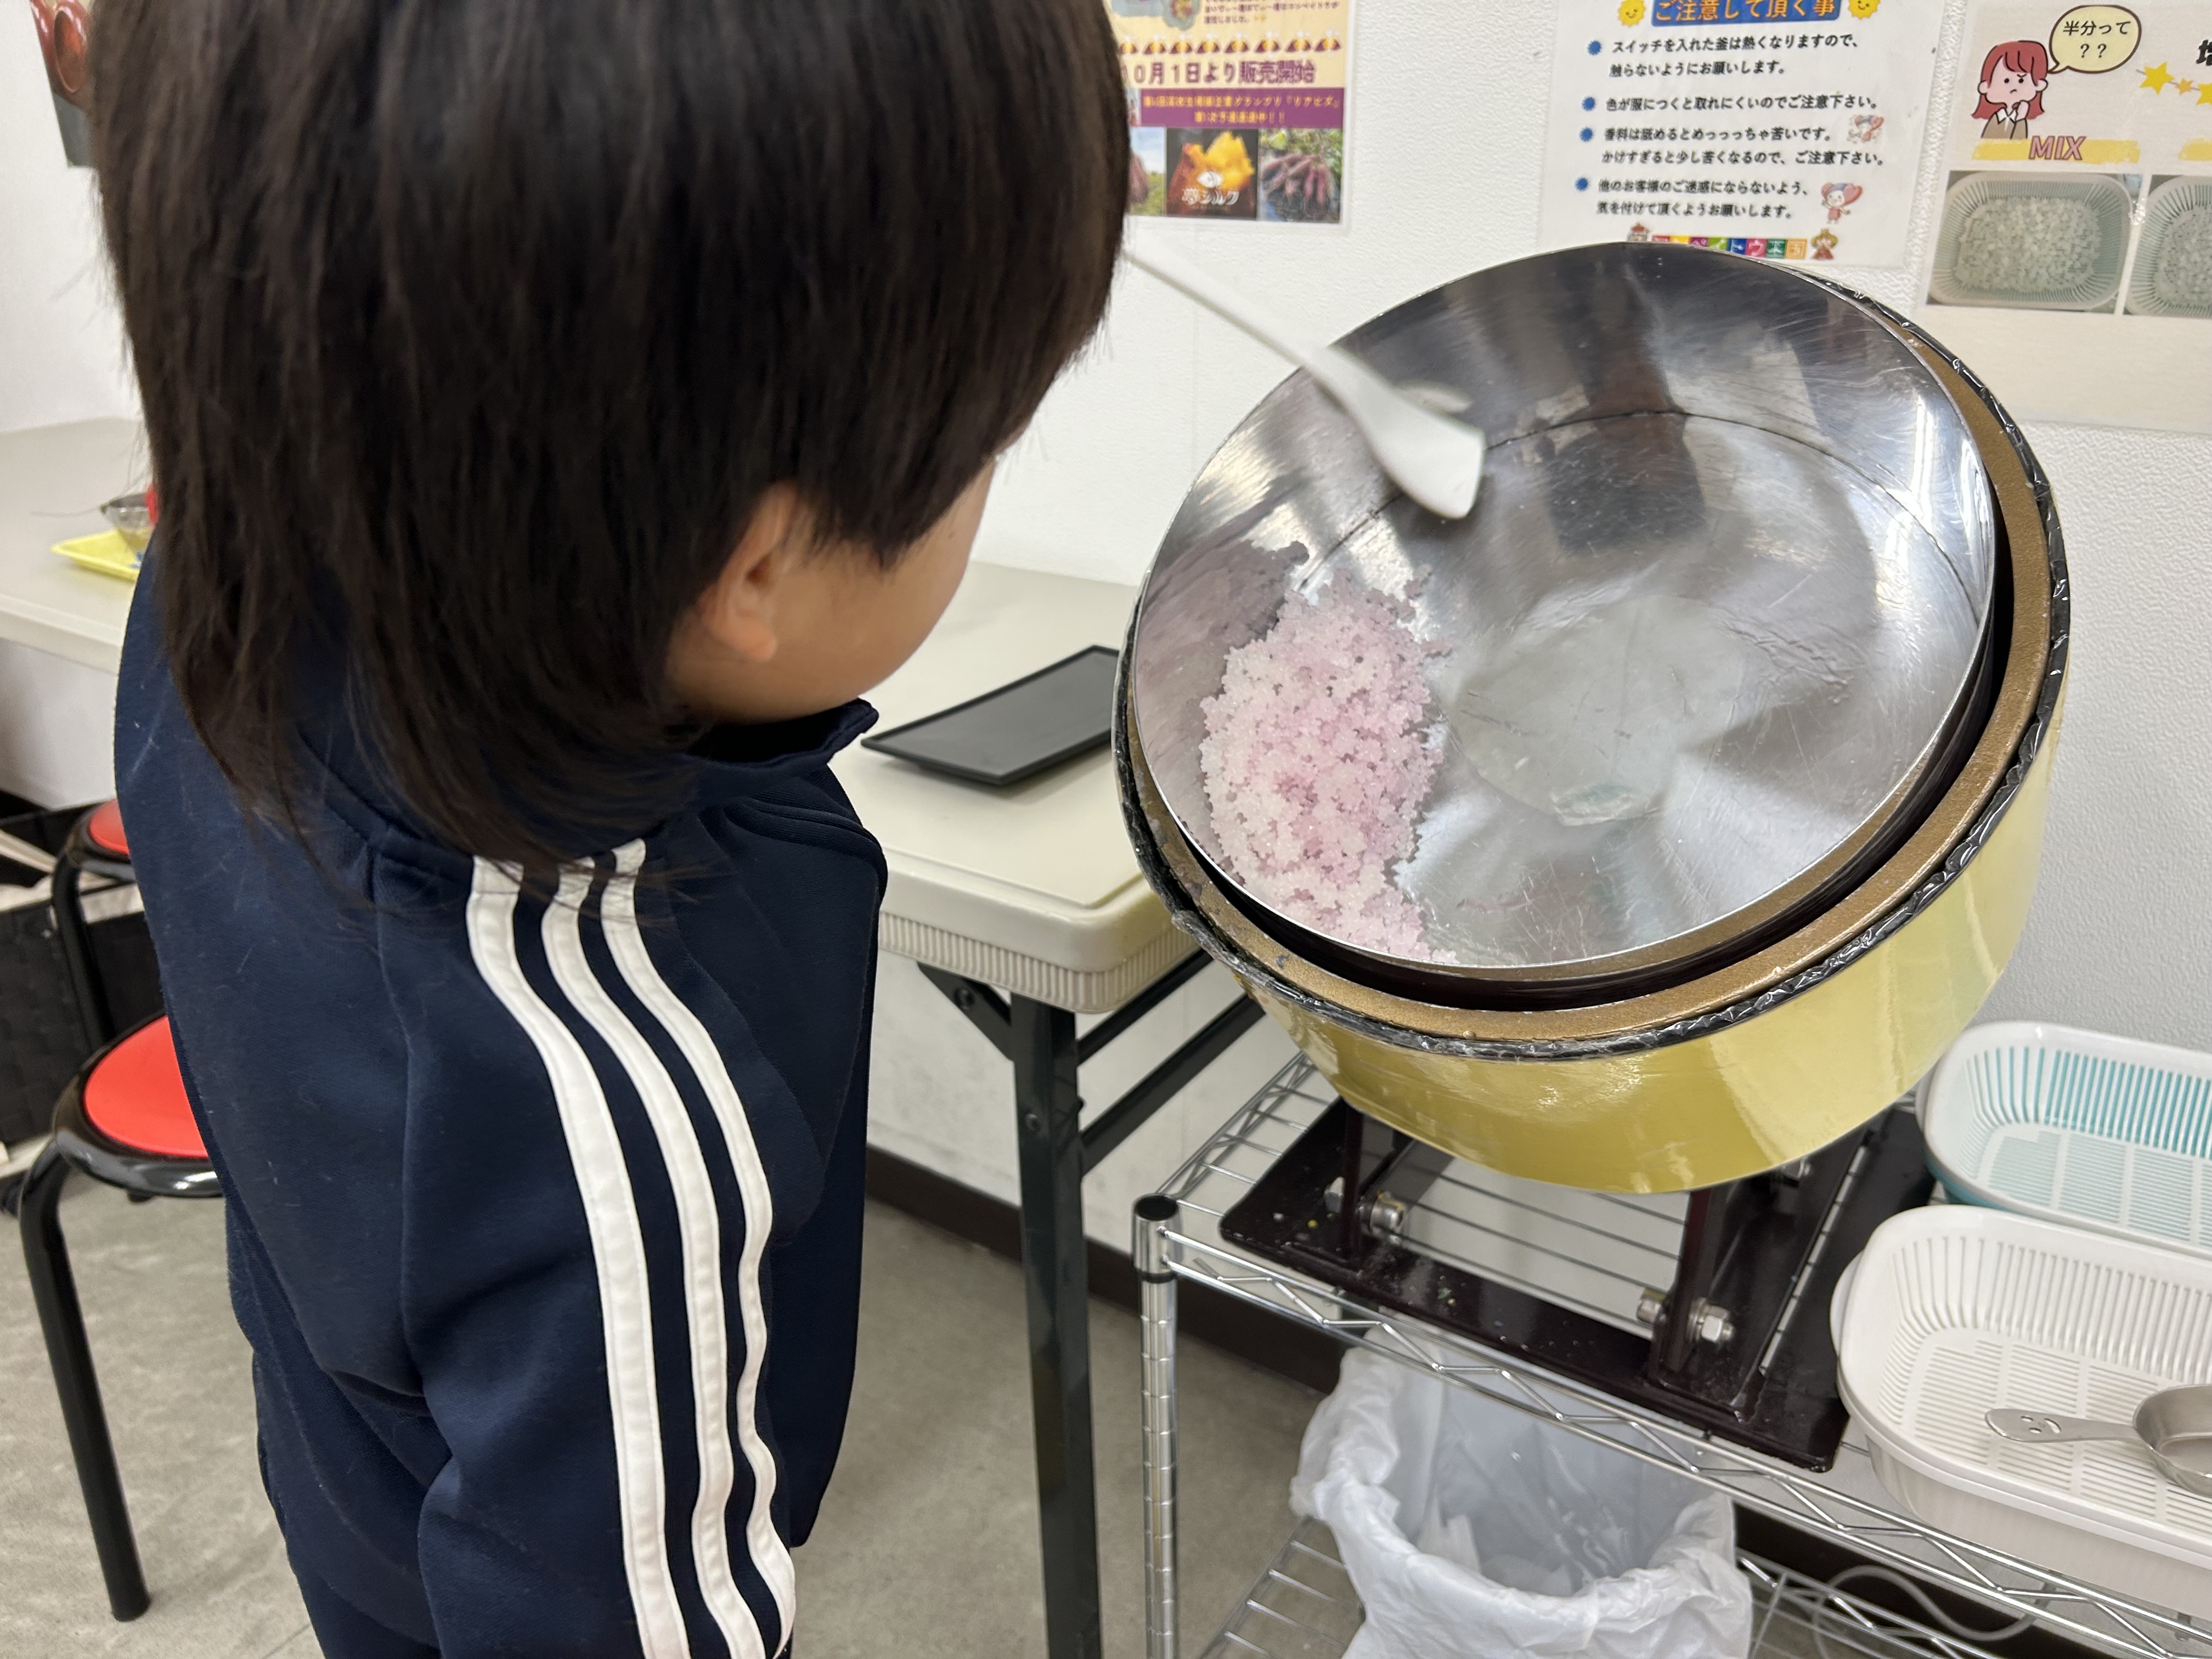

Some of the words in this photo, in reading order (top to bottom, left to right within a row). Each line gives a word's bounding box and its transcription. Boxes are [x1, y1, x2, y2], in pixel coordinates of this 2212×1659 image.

[2063, 20, 2131, 36] 半分って
[1609, 59, 1785, 78] 触らないようにお願いします。
[2029, 136, 2086, 161] MIX
